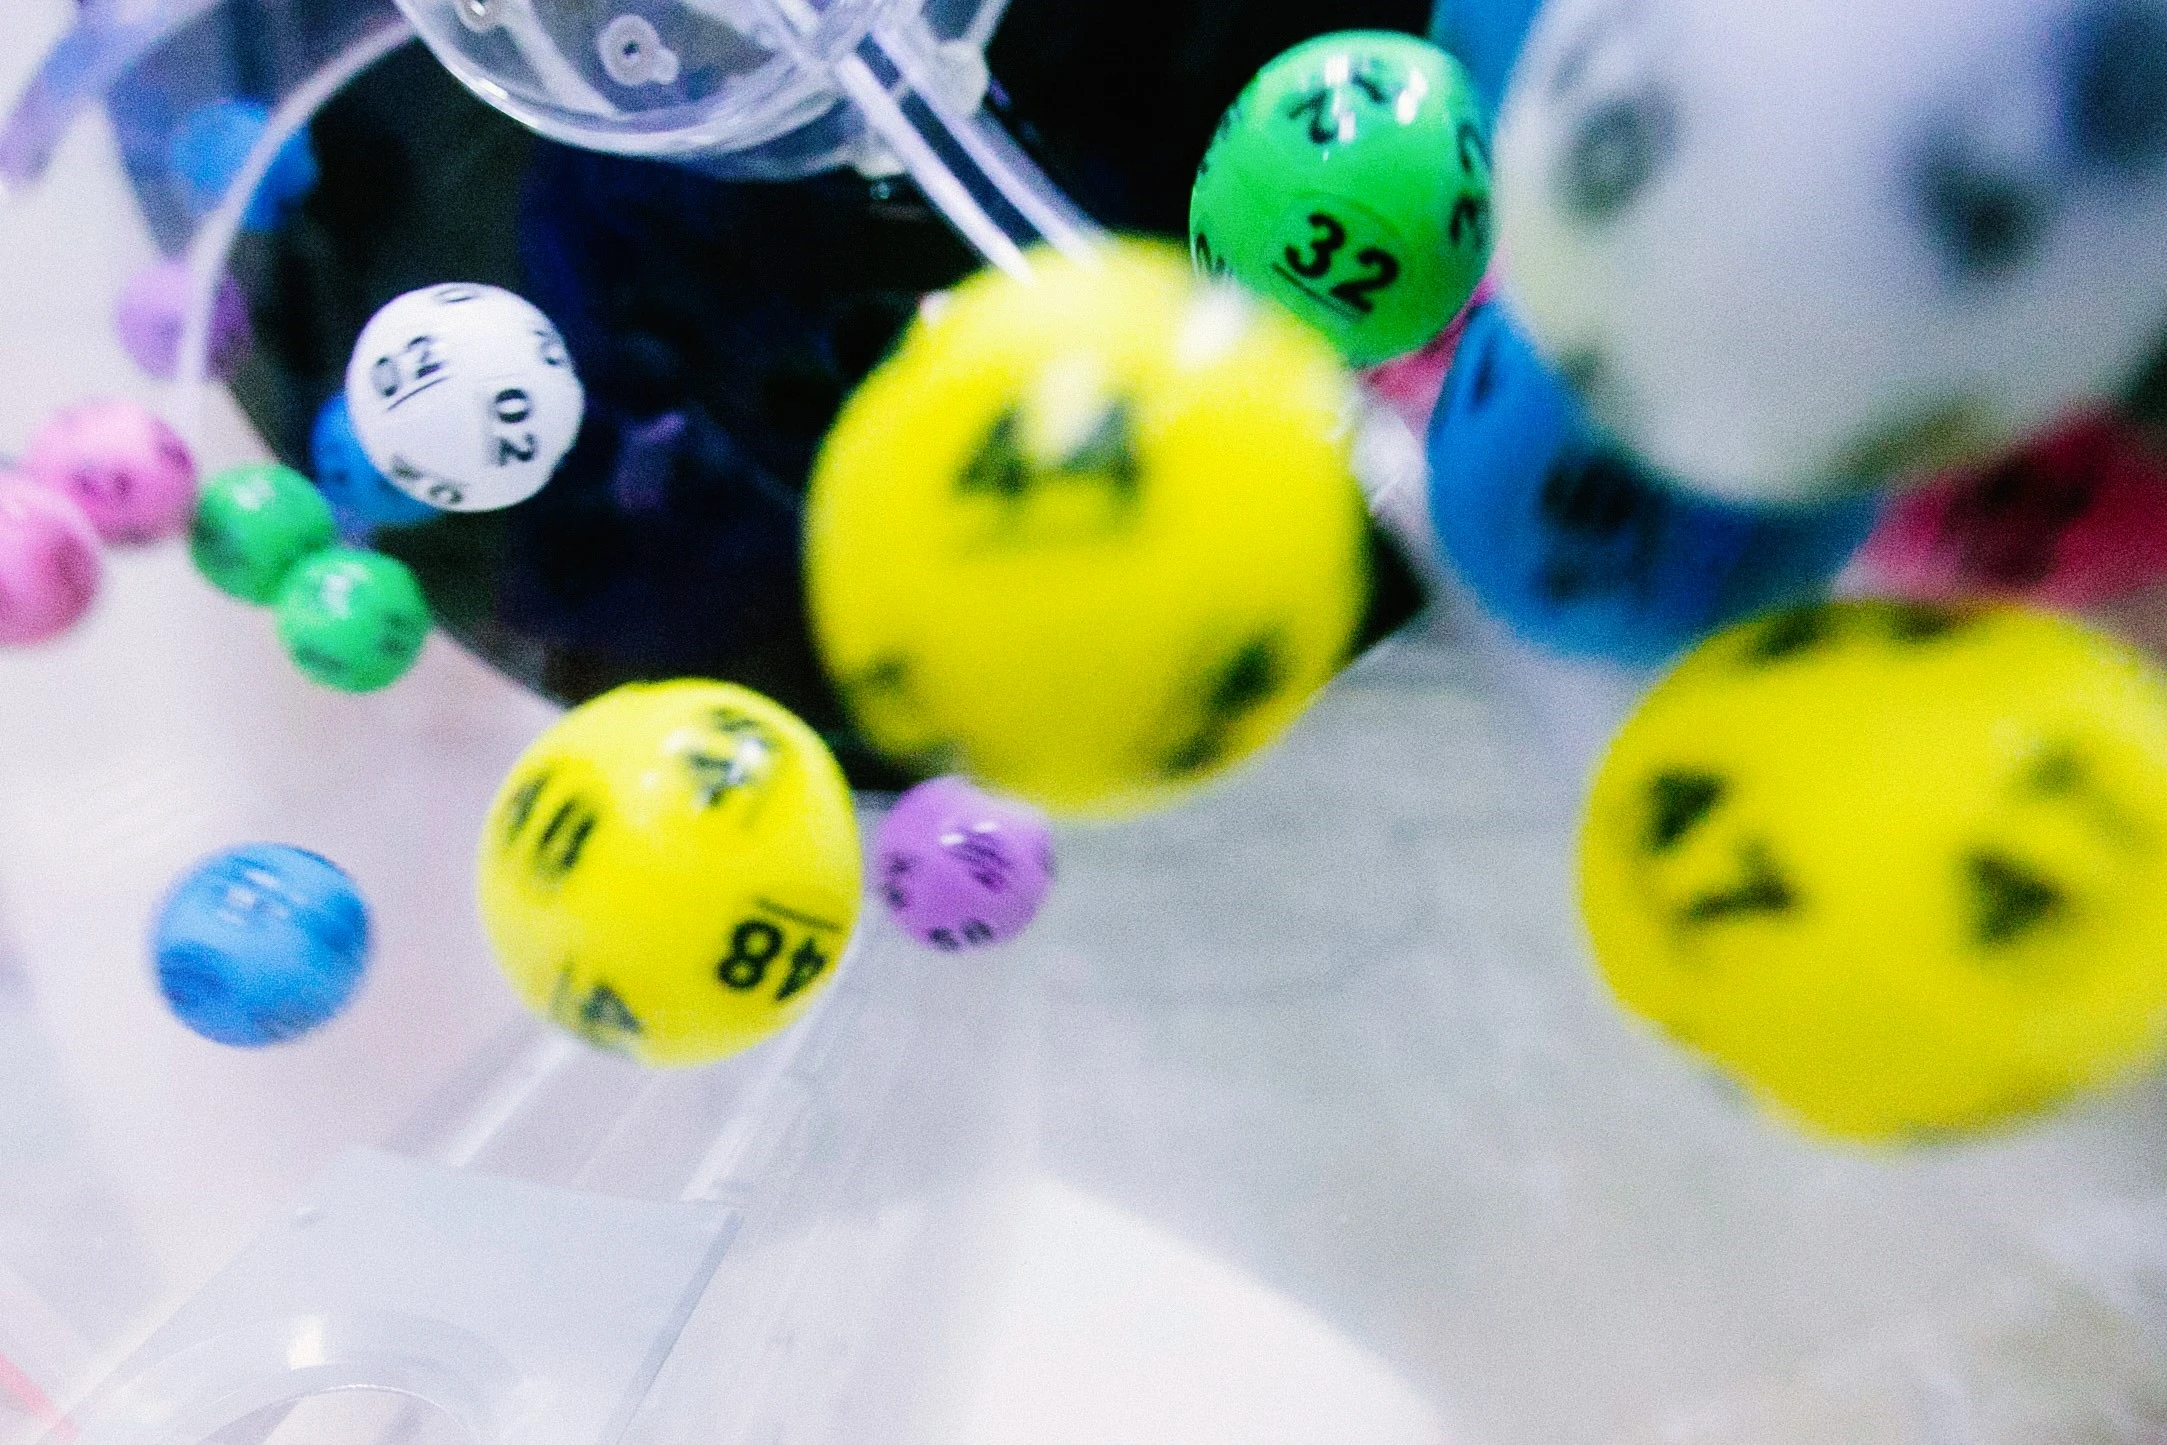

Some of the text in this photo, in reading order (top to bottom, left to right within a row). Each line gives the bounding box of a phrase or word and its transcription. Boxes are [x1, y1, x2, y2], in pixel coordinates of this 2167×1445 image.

[1284, 211, 1400, 315] 32
[491, 387, 538, 468] 02
[714, 918, 829, 1004] 48
